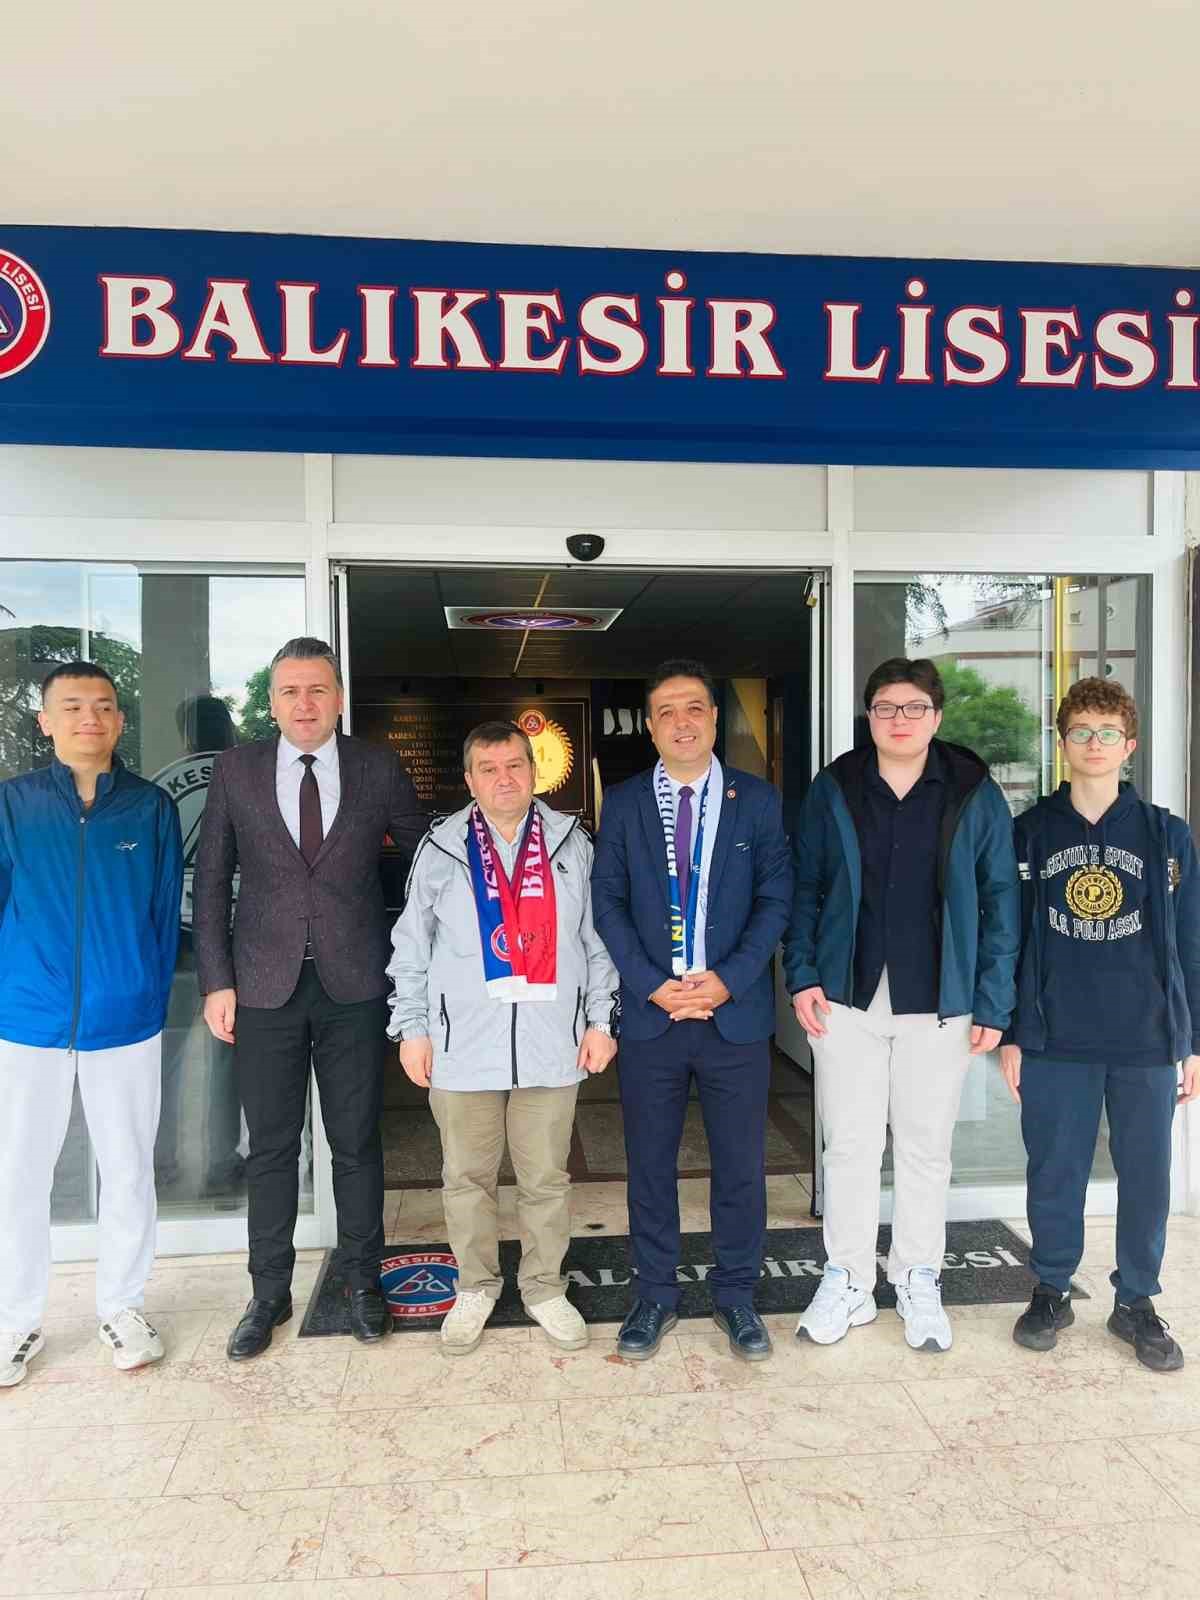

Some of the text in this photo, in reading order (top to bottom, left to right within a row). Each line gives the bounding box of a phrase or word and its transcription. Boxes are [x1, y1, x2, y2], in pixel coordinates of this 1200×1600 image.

[98, 269, 1200, 391] BALIKESİR LİSESİ
[1104, 845, 1143, 879] SPIRIT
[1073, 918, 1105, 941] POLO
